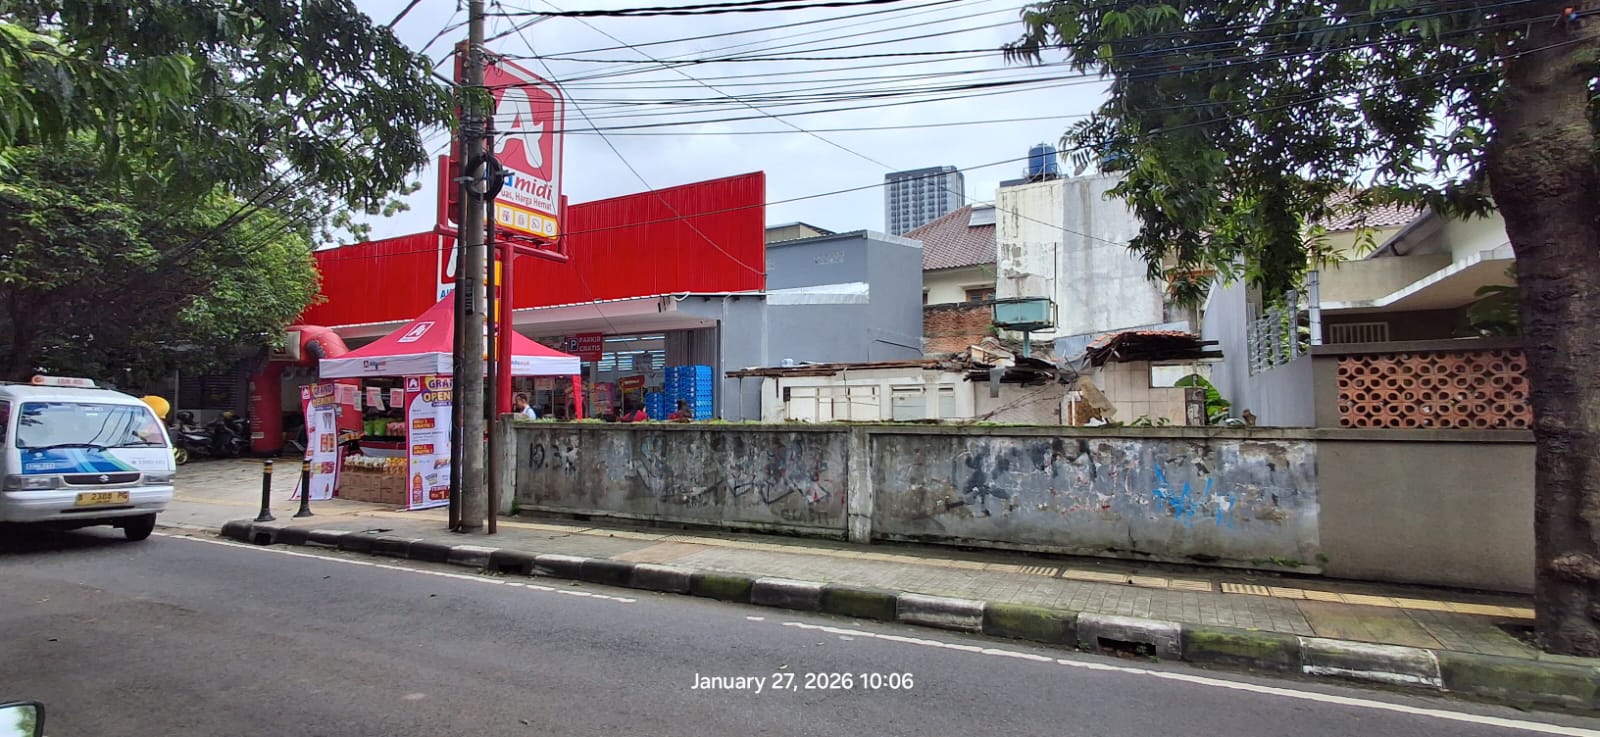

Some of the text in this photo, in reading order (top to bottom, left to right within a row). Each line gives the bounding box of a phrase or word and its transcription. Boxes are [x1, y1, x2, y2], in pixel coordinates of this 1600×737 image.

[501, 189, 514, 201] uas,
[515, 192, 533, 206] Harga
[423, 391, 451, 402] OPEN
